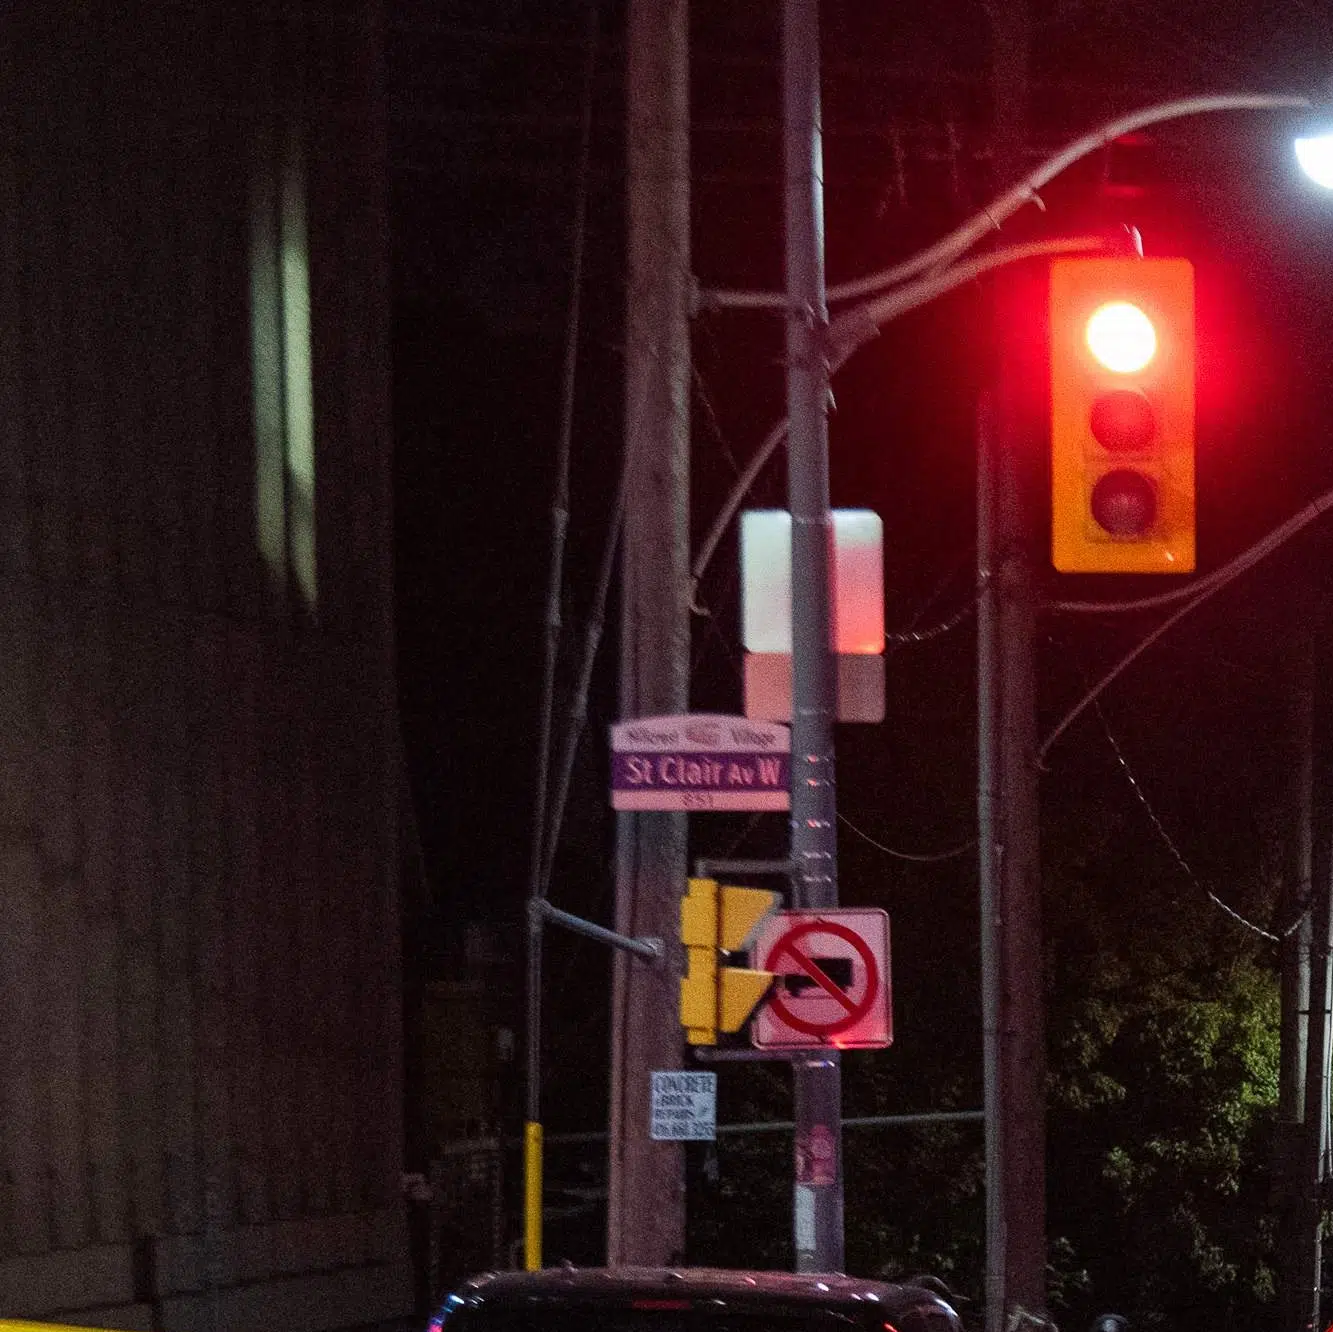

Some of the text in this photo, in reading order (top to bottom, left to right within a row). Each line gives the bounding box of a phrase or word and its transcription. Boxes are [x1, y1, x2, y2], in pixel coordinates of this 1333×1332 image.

[625, 756, 782, 786] St Clair Av W
